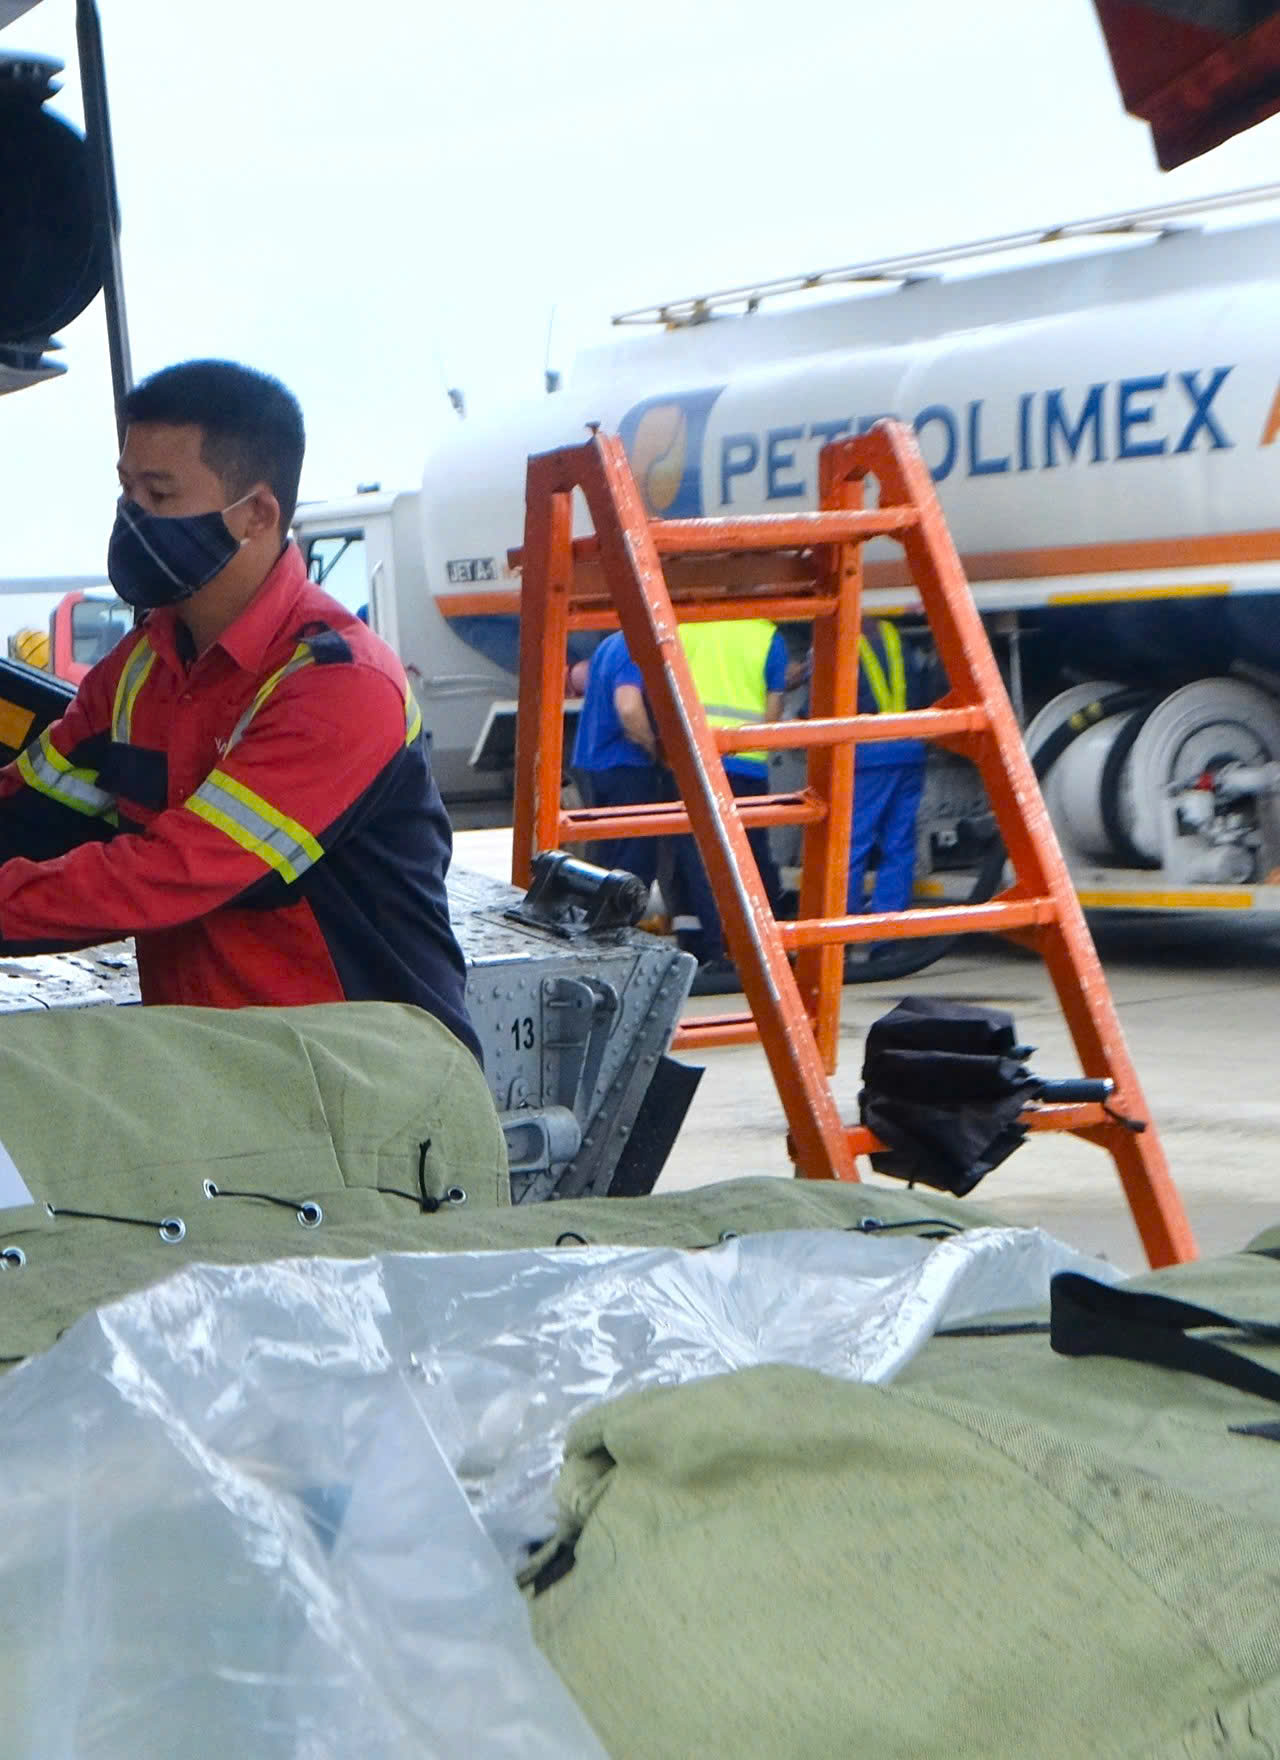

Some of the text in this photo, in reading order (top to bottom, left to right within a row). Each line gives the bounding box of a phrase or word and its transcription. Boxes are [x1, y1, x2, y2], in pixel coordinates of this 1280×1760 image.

[719, 364, 1238, 506] PETOLIMEX
[450, 560, 472, 581] JET
[511, 1017, 535, 1051] 13
